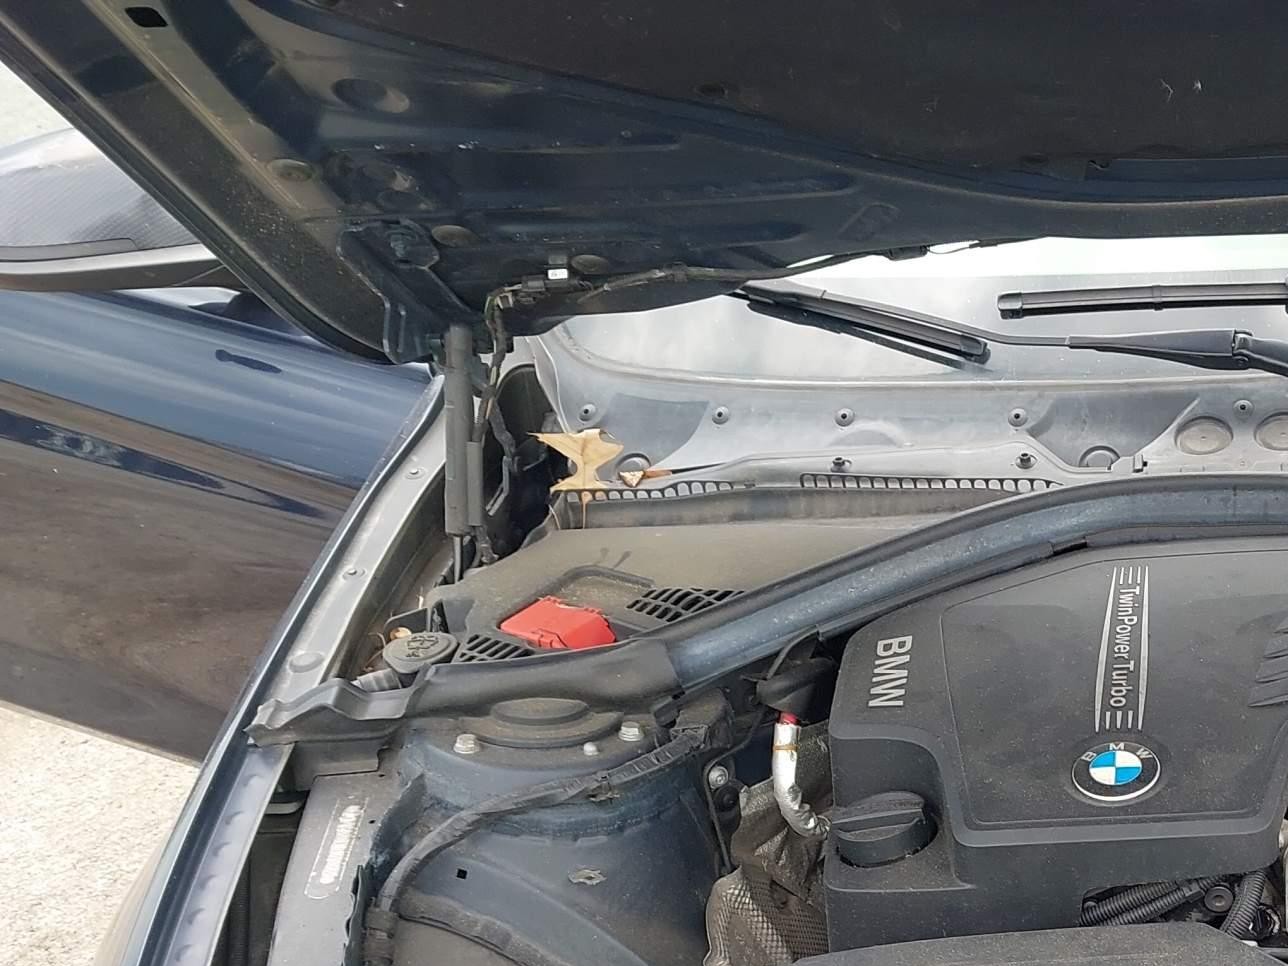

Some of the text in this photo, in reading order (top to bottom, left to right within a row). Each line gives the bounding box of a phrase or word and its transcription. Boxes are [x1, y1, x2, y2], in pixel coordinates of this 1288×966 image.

[868, 635, 913, 708] BMW
[1109, 585, 1140, 708] TwinPower Turbo
[1080, 742, 1153, 761] BMW
